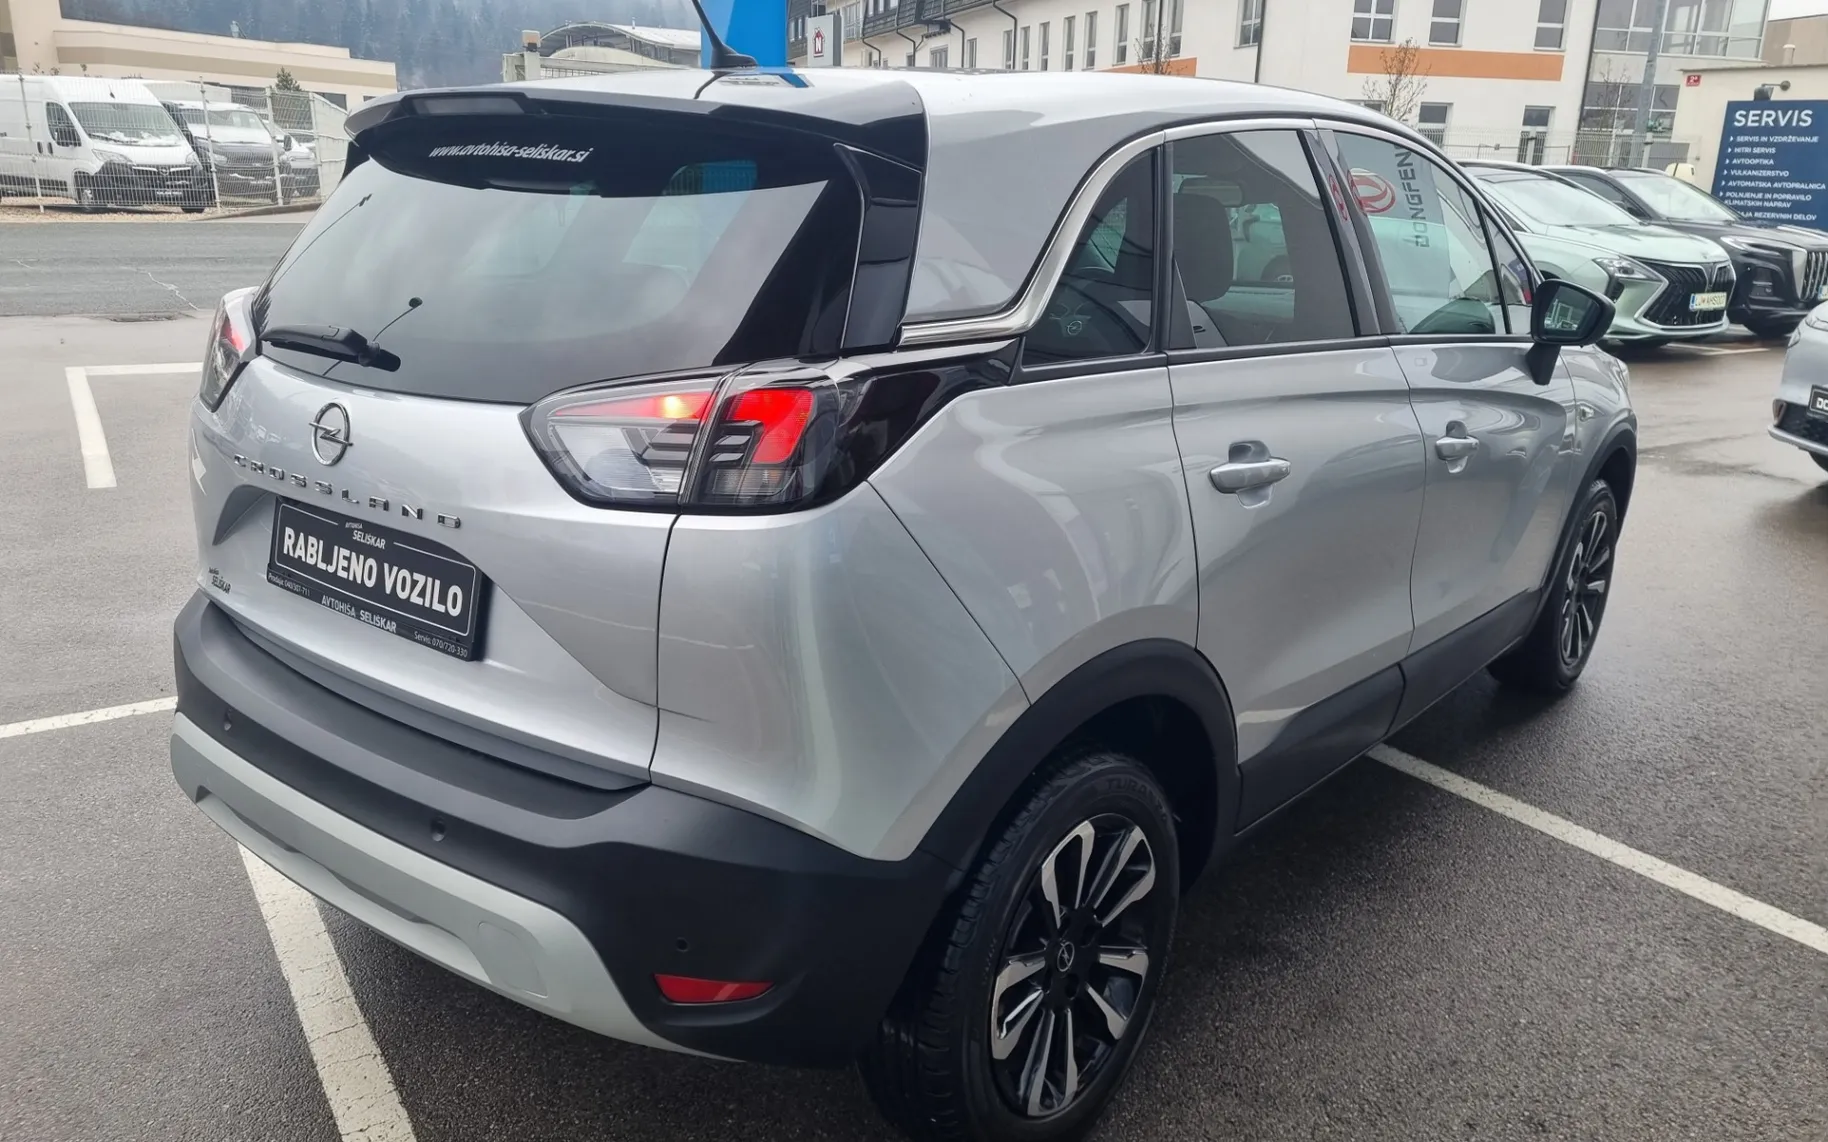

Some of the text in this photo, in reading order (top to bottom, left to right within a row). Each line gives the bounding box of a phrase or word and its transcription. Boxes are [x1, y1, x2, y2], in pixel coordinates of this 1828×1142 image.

[1733, 109, 1813, 127] SERVIS
[1736, 134, 1819, 143] SERVIS IN VZDRŽEVANJE
[428, 141, 594, 162] www.avtohisa-seliskar.si
[1730, 169, 1789, 177] VULKANIZERSTVO
[1727, 180, 1771, 188] AVTOMATSKA
[1394, 144, 1430, 248] DONGFEN
[1724, 199, 1763, 207] KLIMATSKIH
[1725, 191, 1763, 199] POLNJENJE
[1773, 193, 1812, 201] POPRAVILO
[234, 453, 461, 530] CROSSLAND
[352, 530, 386, 550] SELIŠKAR
[283, 526, 463, 618] RABLJENO VOZILO
[321, 594, 397, 634] AVTOHIŠA SELIŠKAR
